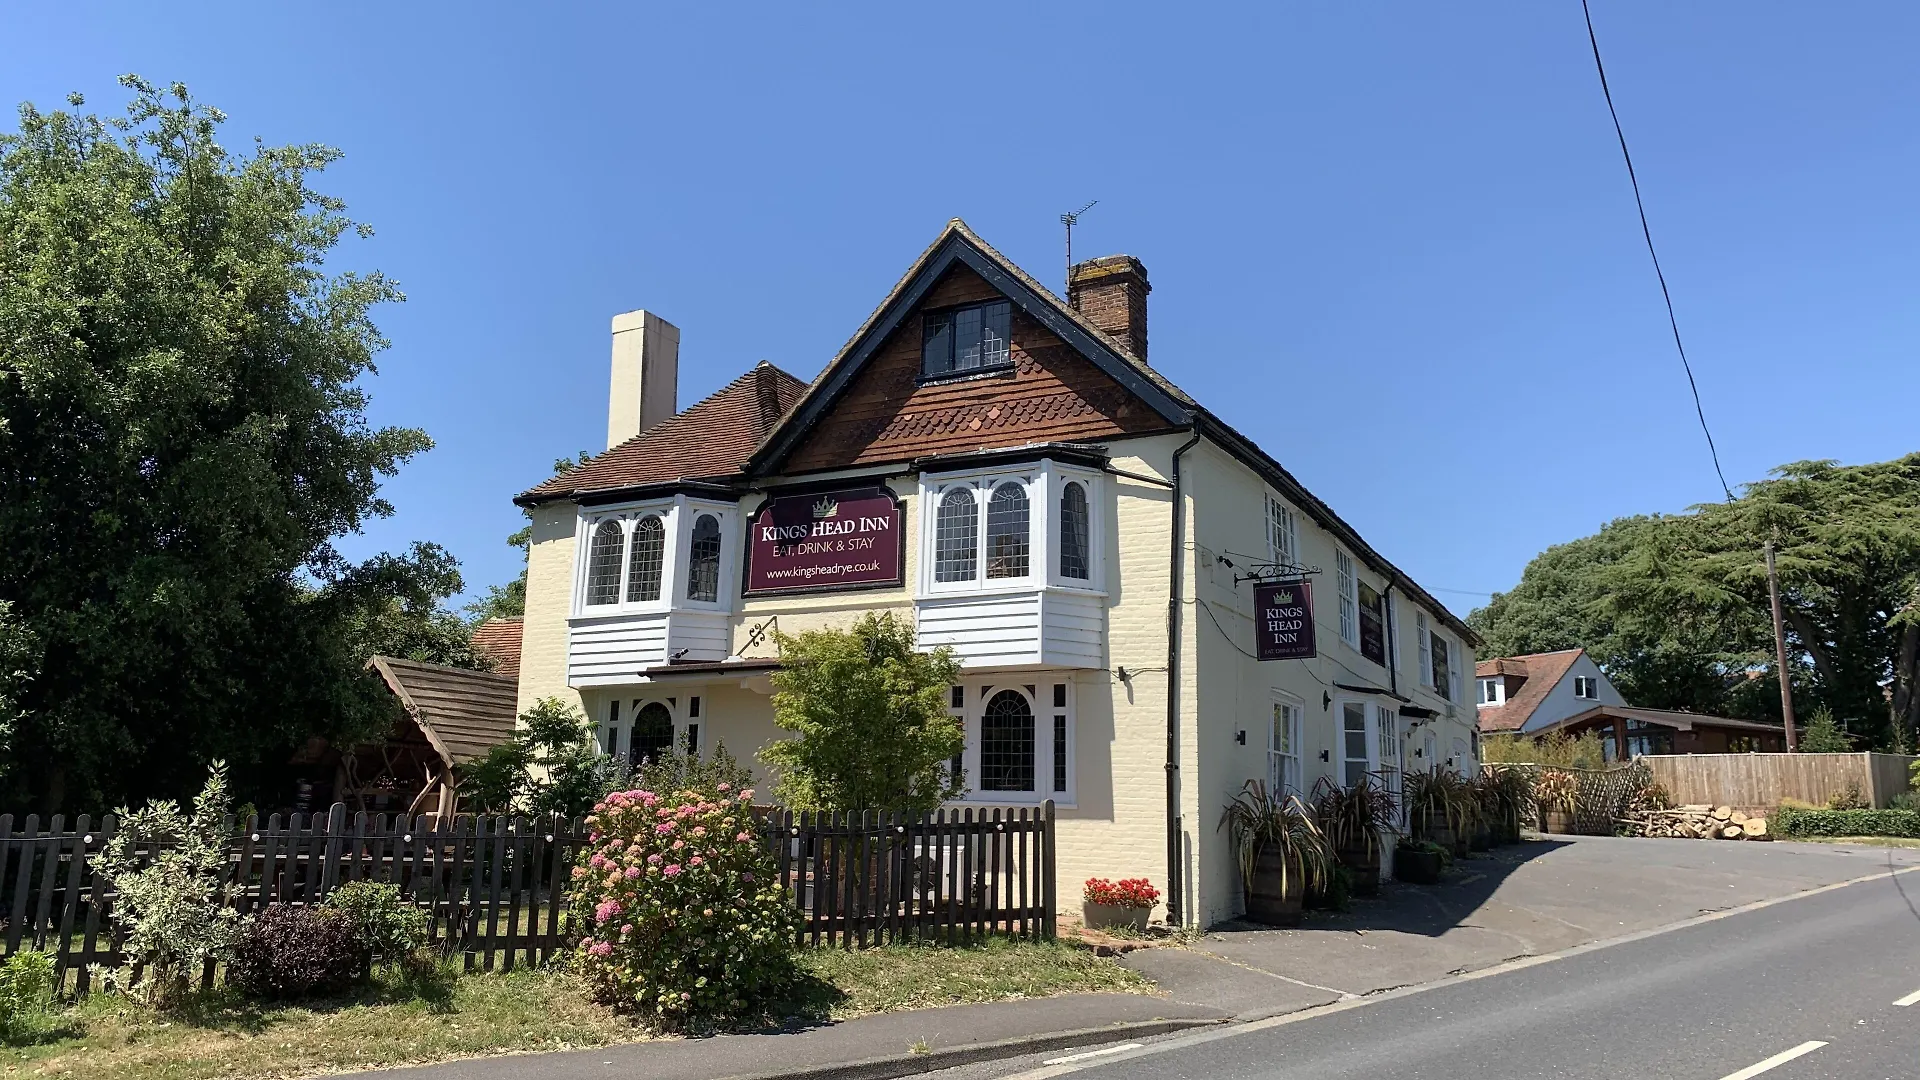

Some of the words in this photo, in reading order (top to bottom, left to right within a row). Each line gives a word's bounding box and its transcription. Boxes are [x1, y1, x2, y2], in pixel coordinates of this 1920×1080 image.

[761, 524, 808, 541] KINGS
[811, 520, 855, 537] HEAD
[859, 516, 890, 532] INN
[773, 544, 795, 557] EAT,
[798, 541, 834, 555] DRINK
[836, 540, 845, 552] &
[848, 537, 876, 551] STAY
[766, 559, 881, 579] www.kingsheadrye.co.uk
[1265, 607, 1303, 619] KINGS
[1268, 620, 1302, 631] HEAD
[1274, 633, 1298, 644] INN
